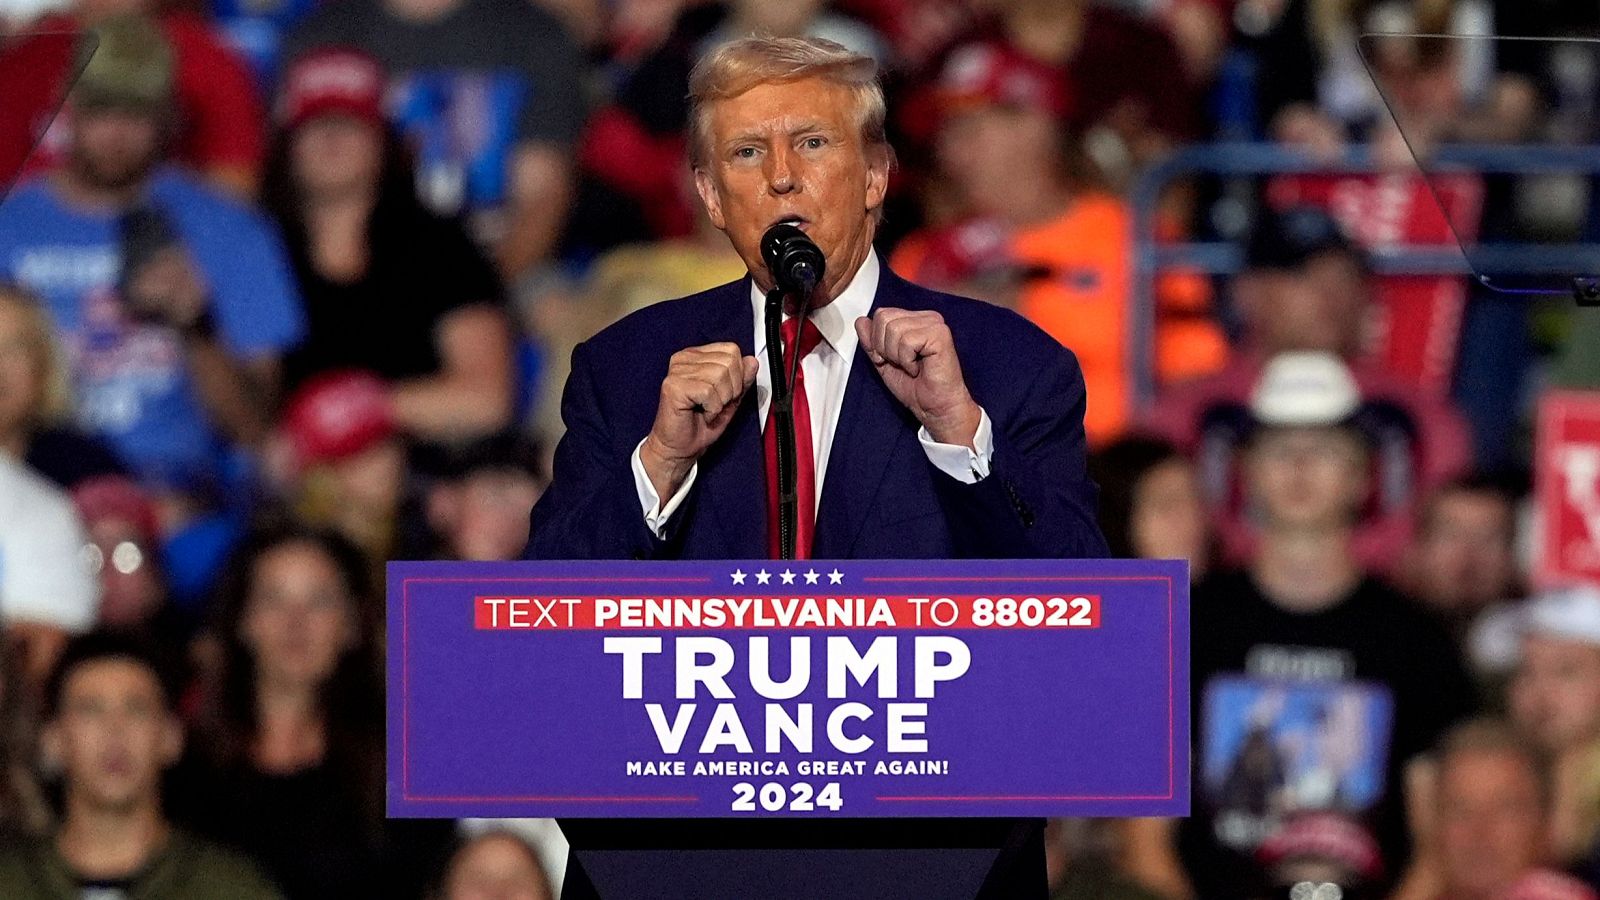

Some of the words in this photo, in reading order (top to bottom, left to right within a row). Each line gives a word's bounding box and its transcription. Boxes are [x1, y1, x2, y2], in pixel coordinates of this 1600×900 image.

[484, 598, 582, 628] TEXT
[594, 598, 897, 628] PENNSYLVANIA
[907, 597, 959, 627] TO
[971, 597, 1092, 627] 88022
[603, 636, 971, 700] TRUMP
[644, 702, 929, 754] VANCE
[626, 761, 686, 776] MAKE
[692, 760, 790, 776] AMERICA
[797, 760, 867, 776] GREAT
[873, 760, 949, 775] AGAIN!
[731, 782, 844, 812] 2024
